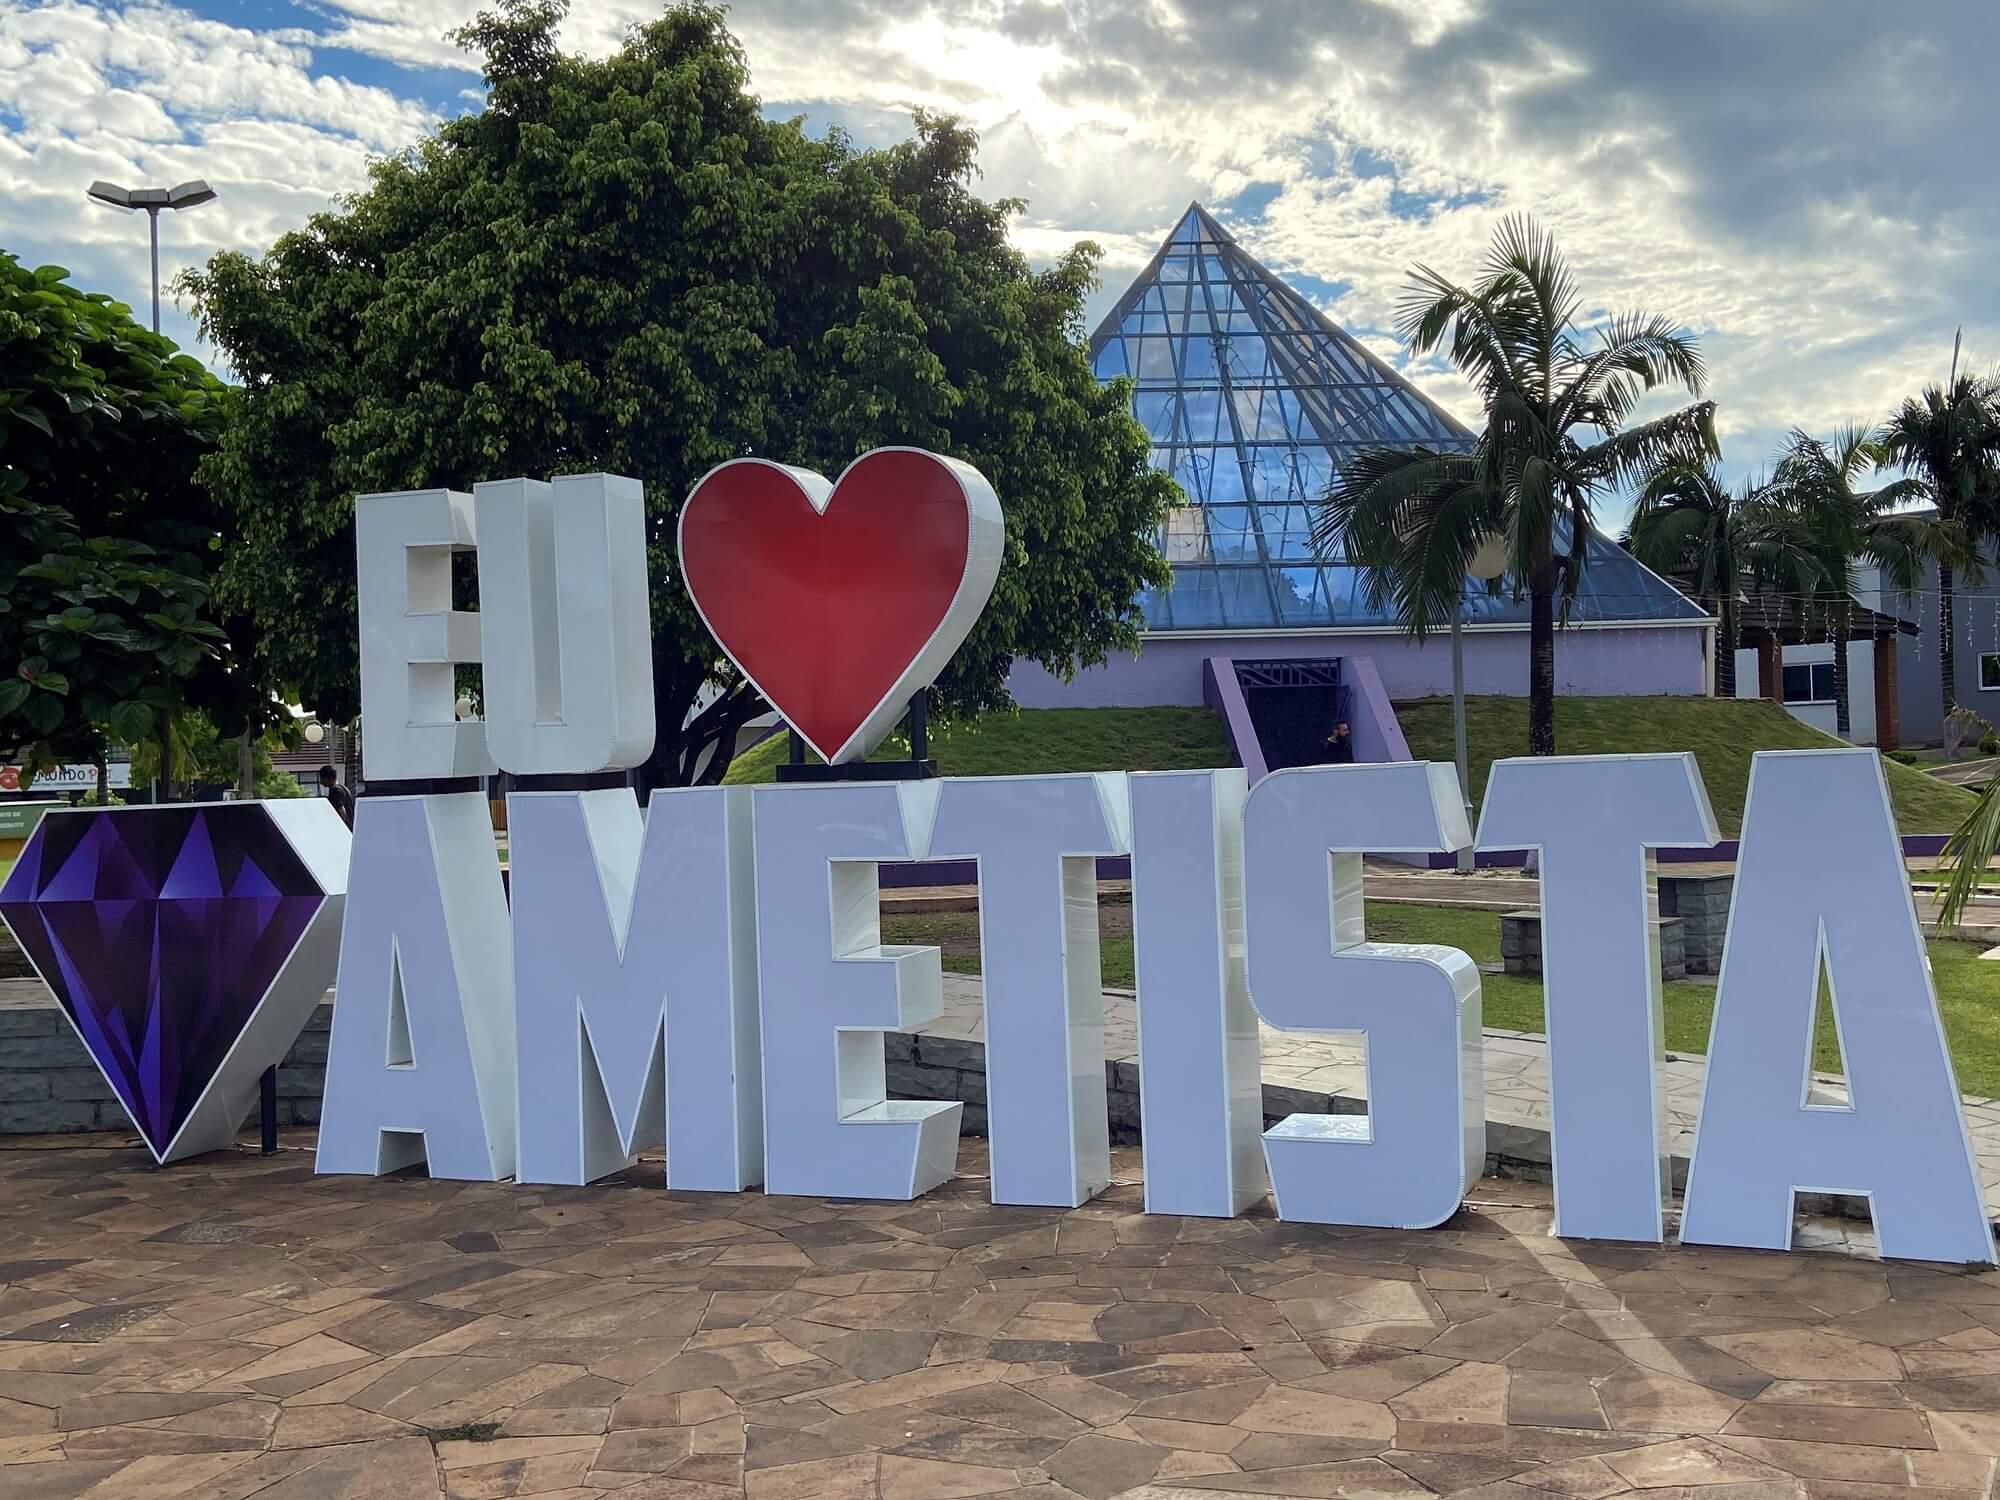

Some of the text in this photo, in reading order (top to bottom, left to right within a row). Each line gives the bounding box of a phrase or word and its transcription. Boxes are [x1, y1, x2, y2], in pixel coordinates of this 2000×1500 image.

[87, 767, 113, 780] PT
[356, 472, 656, 781] EU
[314, 748, 1998, 1265] AMETISTA
